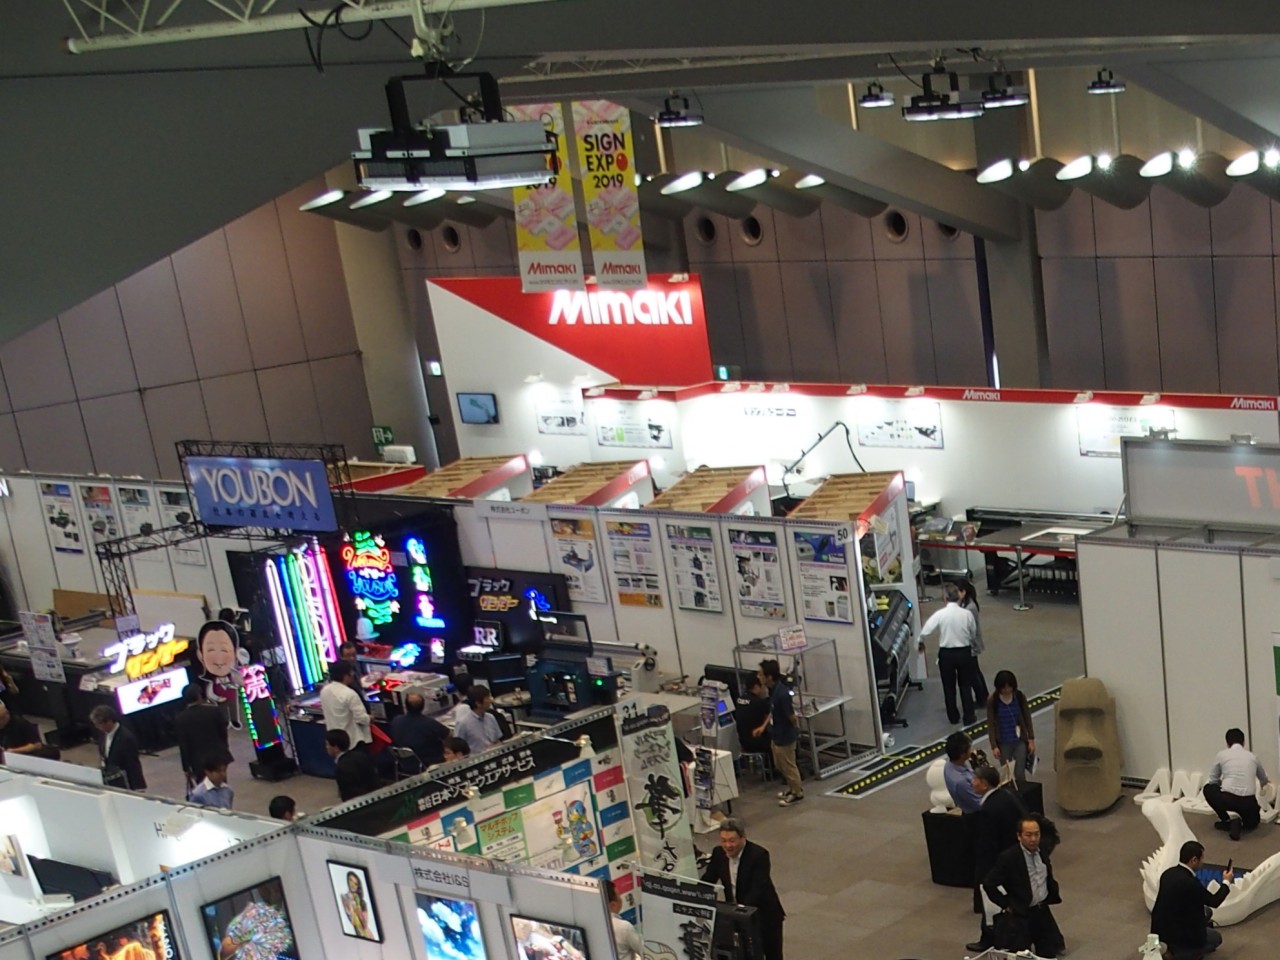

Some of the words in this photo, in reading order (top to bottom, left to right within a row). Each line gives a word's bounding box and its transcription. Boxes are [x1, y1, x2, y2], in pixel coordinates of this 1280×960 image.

[584, 133, 625, 152] SIGN
[586, 153, 629, 172] EXPO
[593, 174, 624, 189] 2019
[202, 467, 319, 509] YOUBON
[836, 527, 849, 542] 50
[473, 626, 499, 646] RR
[414, 866, 471, 888] 株式会社I&S
